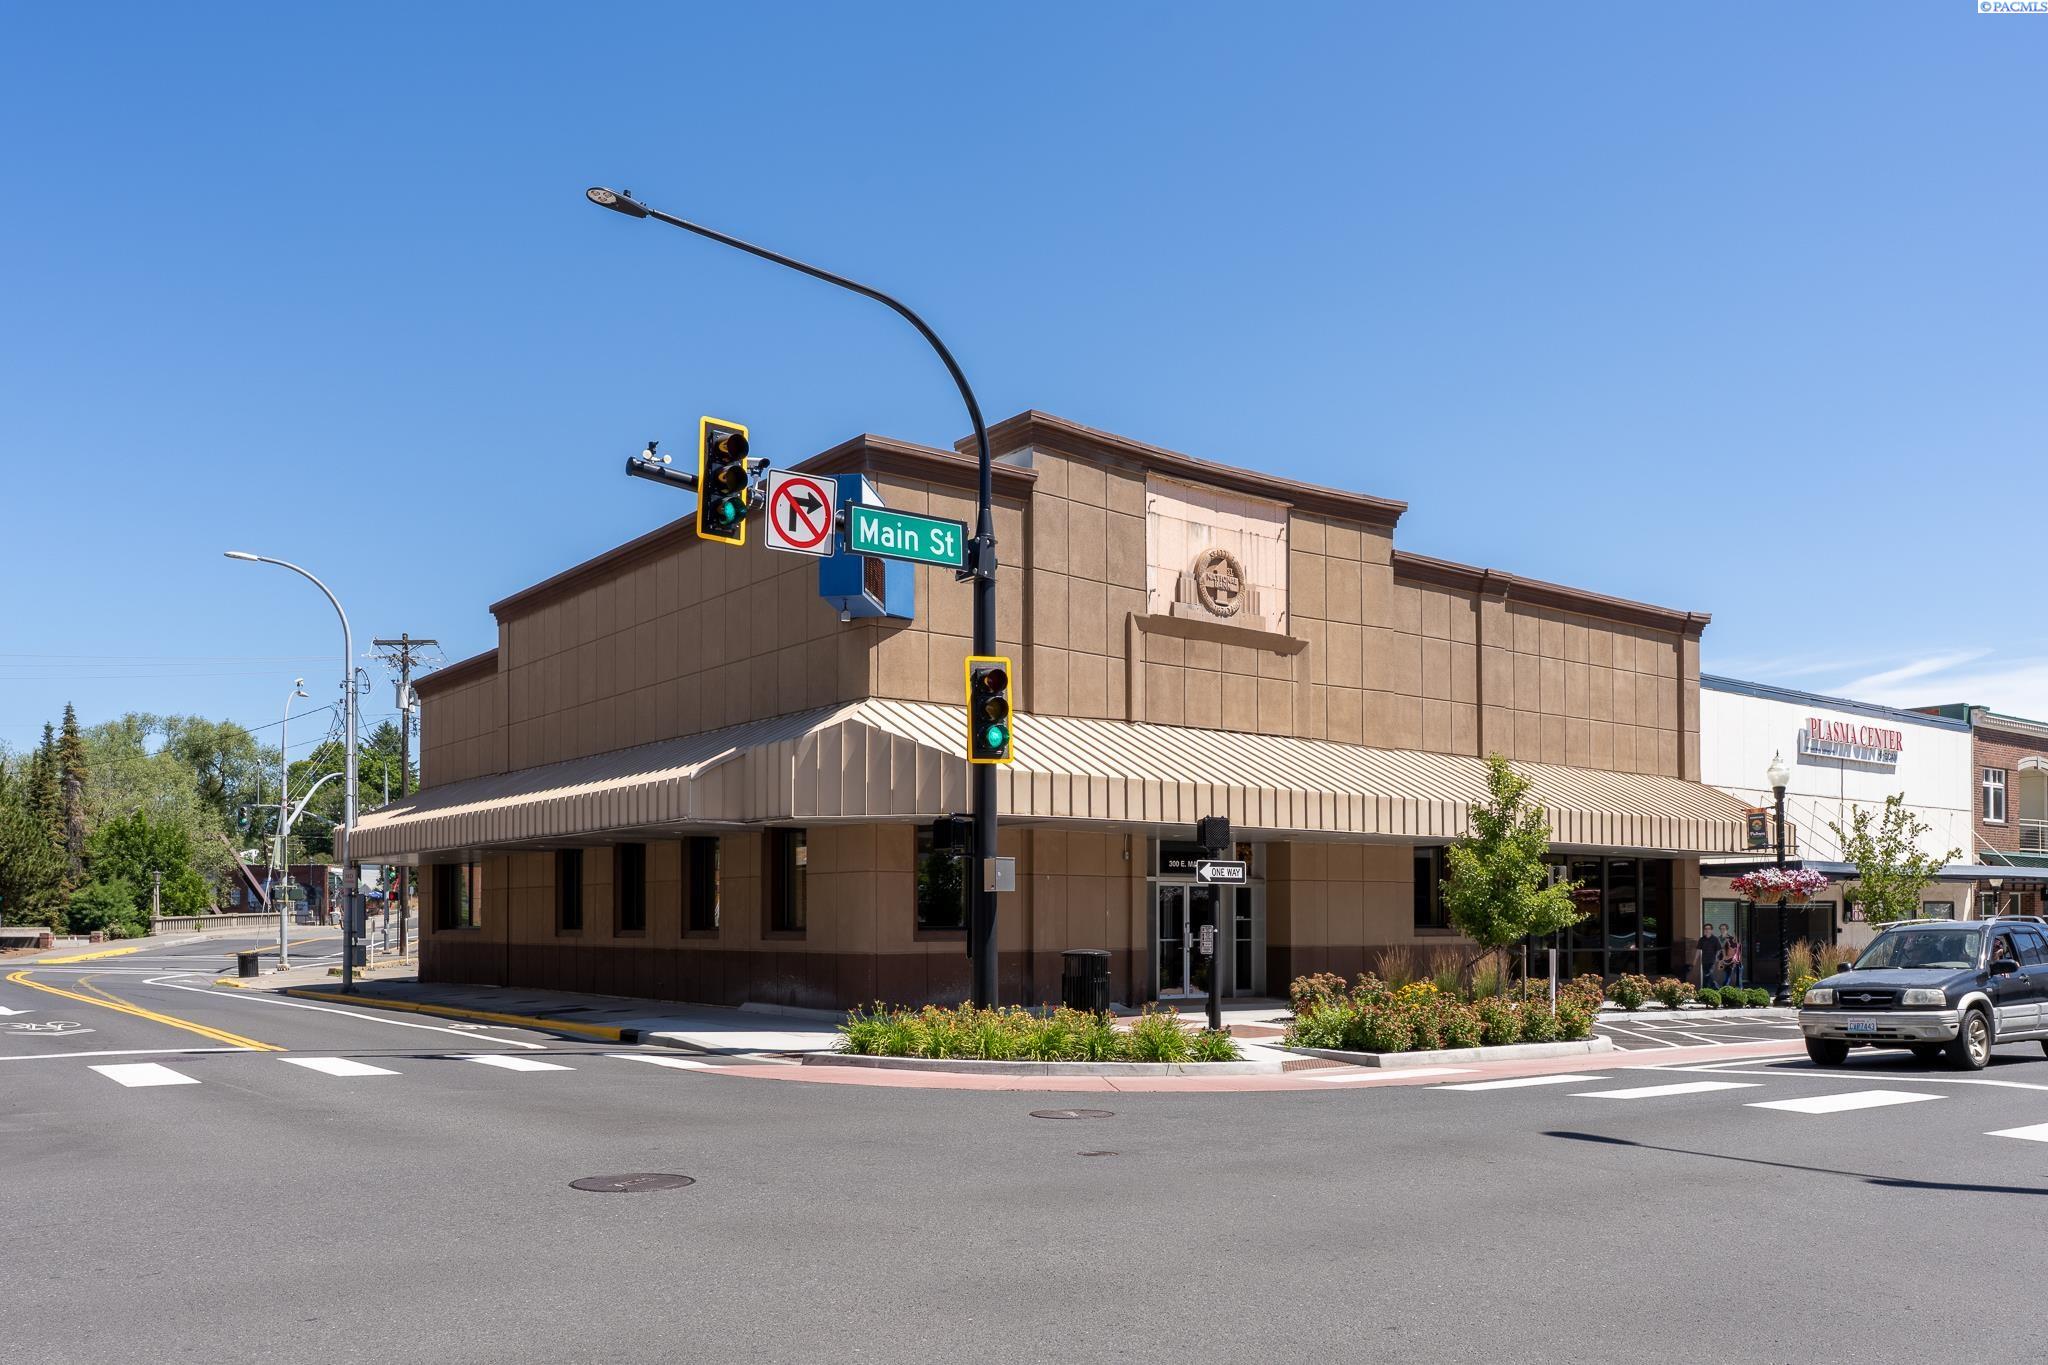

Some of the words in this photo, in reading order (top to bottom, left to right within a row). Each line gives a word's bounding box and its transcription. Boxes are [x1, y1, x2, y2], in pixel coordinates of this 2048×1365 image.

[860, 516, 919, 552] Main
[929, 528, 955, 557] St
[1810, 718, 1857, 745] PLASMA
[1860, 726, 1903, 751] CENTER
[1168, 860, 1180, 868] 300
[1180, 860, 1187, 868] E.
[1211, 867, 1225, 876] ONE
[1226, 868, 1241, 877] WAY
